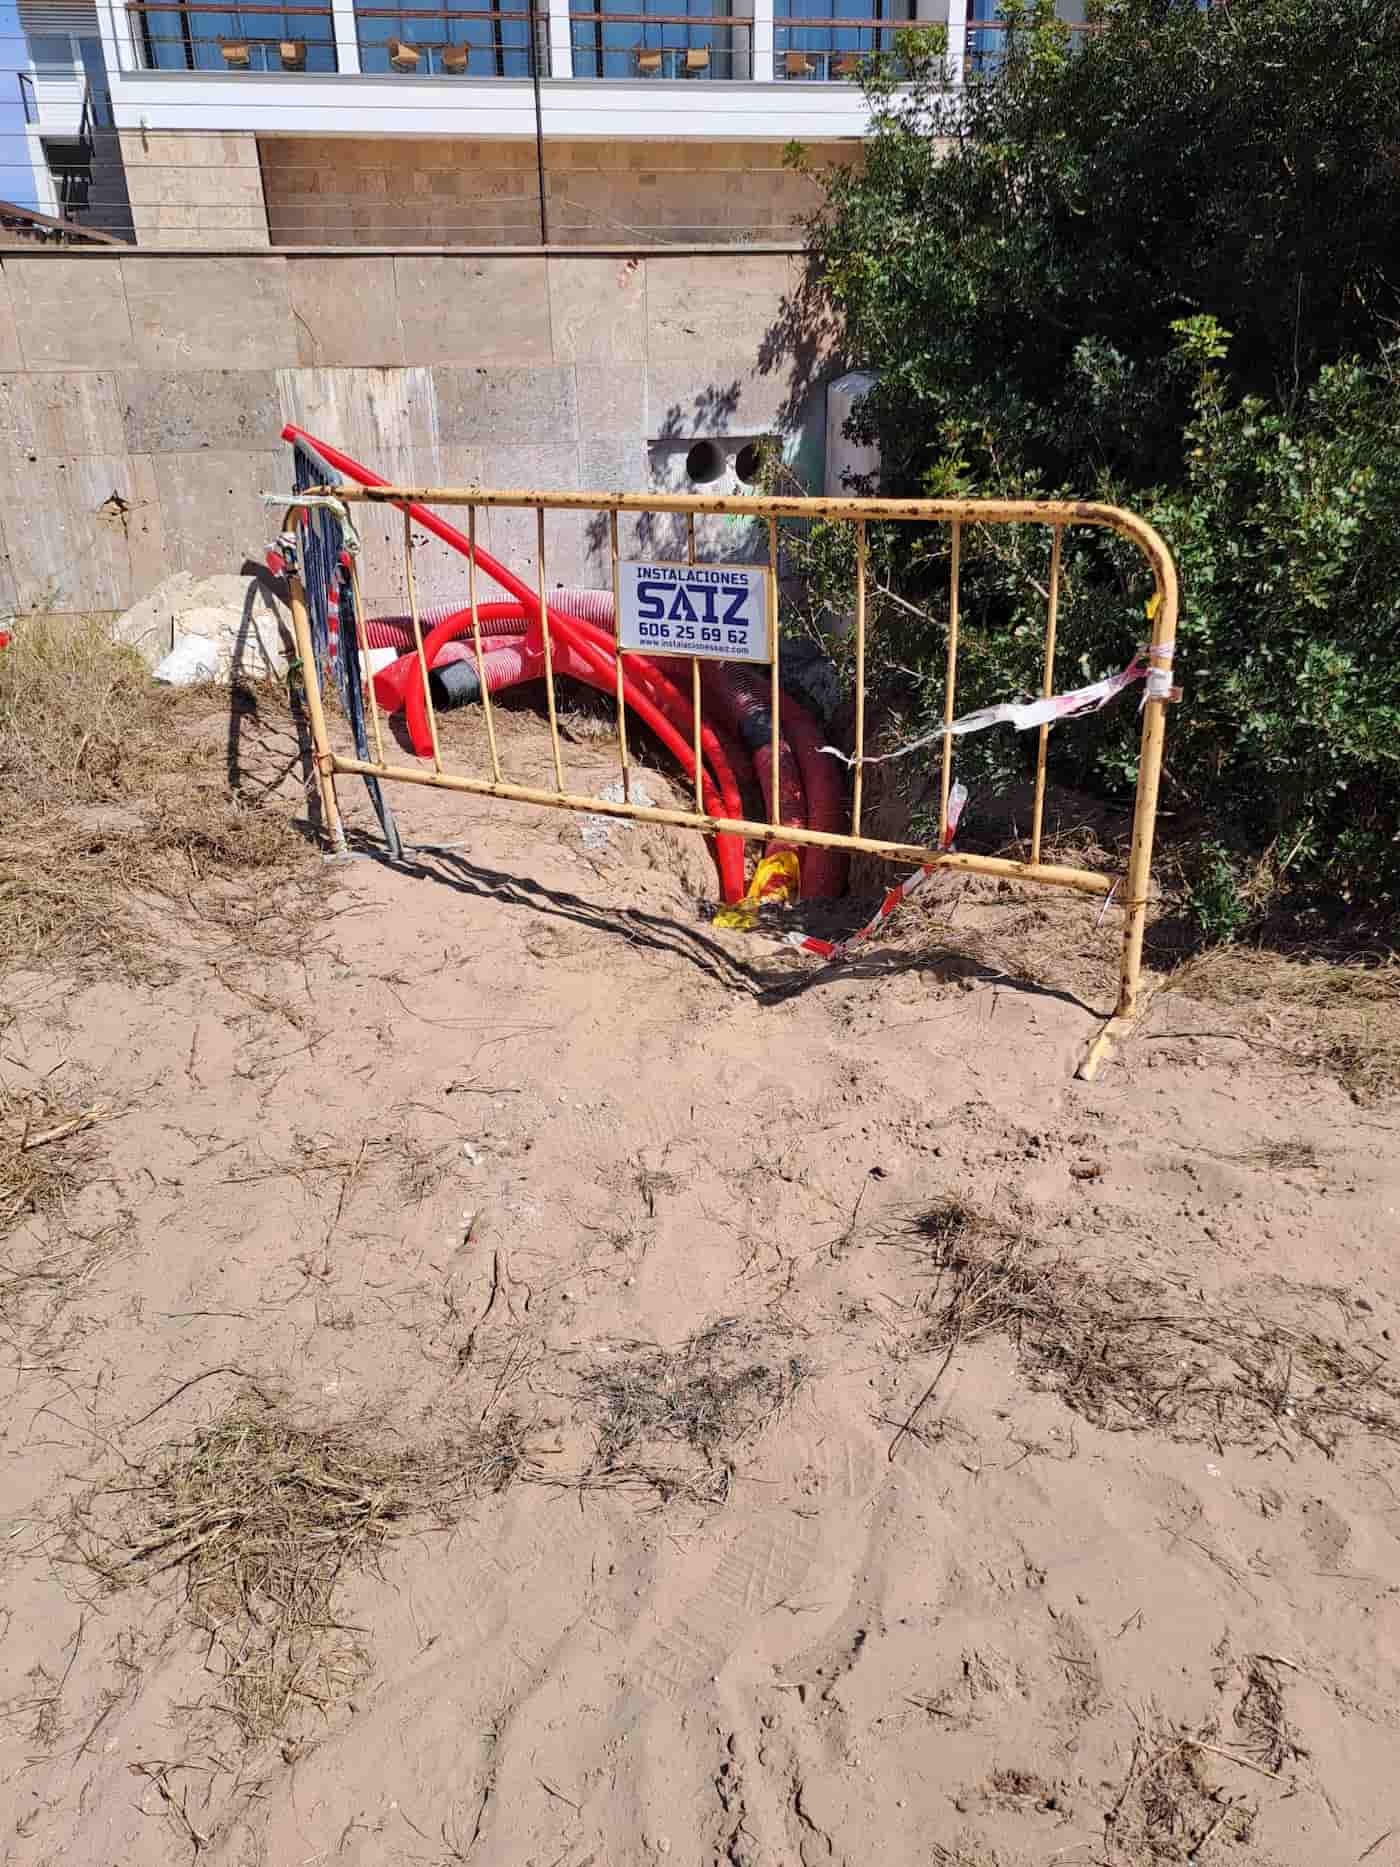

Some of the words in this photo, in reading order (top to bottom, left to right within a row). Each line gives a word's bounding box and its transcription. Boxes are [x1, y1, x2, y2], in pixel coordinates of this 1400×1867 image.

[637, 567, 749, 585] INSTALACIONES
[637, 581, 749, 626] SAIZ
[639, 622, 670, 638] 606
[676, 625, 695, 640] 25
[701, 628, 721, 642] 69
[728, 630, 747, 644] 62
